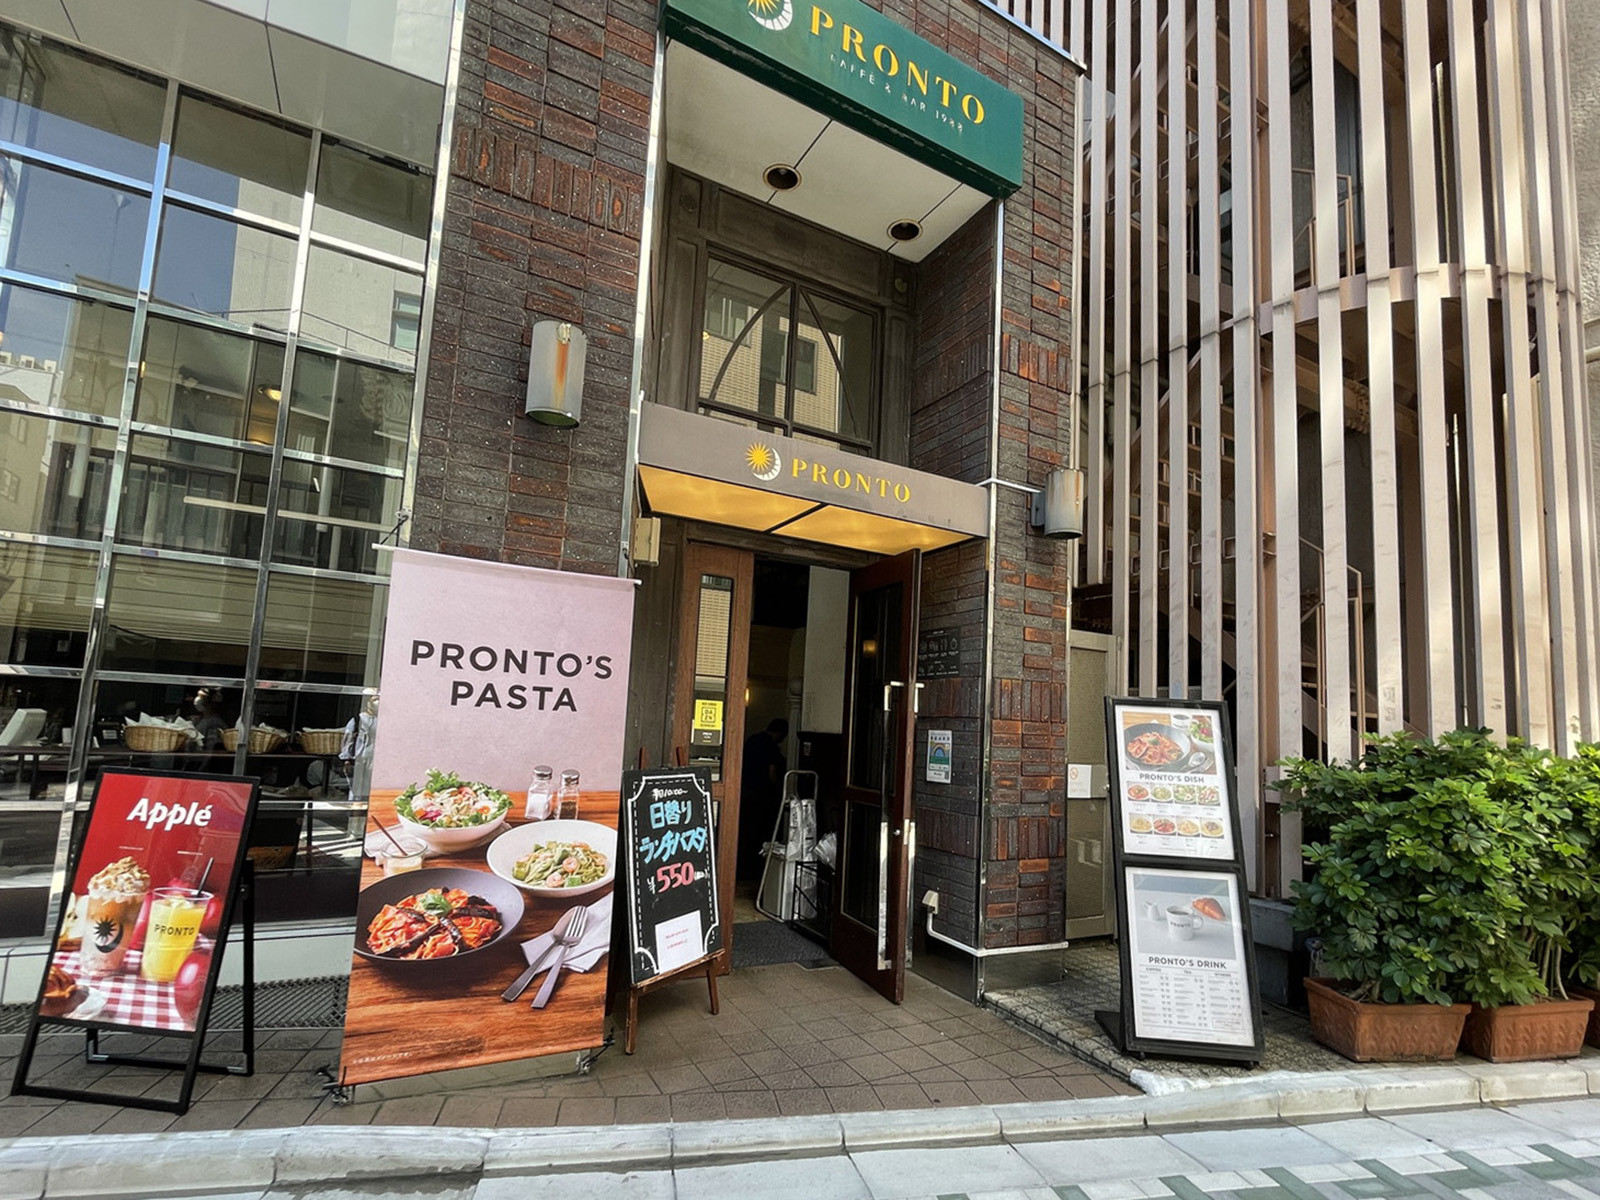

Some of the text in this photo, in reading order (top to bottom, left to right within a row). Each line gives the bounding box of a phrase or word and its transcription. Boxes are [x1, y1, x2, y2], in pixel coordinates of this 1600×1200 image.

[810, 5, 985, 125] PRONTO
[792, 458, 911, 503] PRONTO
[410, 639, 613, 680] PRONTO'S
[450, 680, 578, 713] PASTA
[1139, 772, 1205, 784] PRONTO'S DISH
[649, 800, 692, 829] 日替り
[639, 826, 707, 864] ランチパスタ
[153, 923, 196, 937] PRONTO
[1148, 955, 1227, 970] PRONTO'S DRINK
